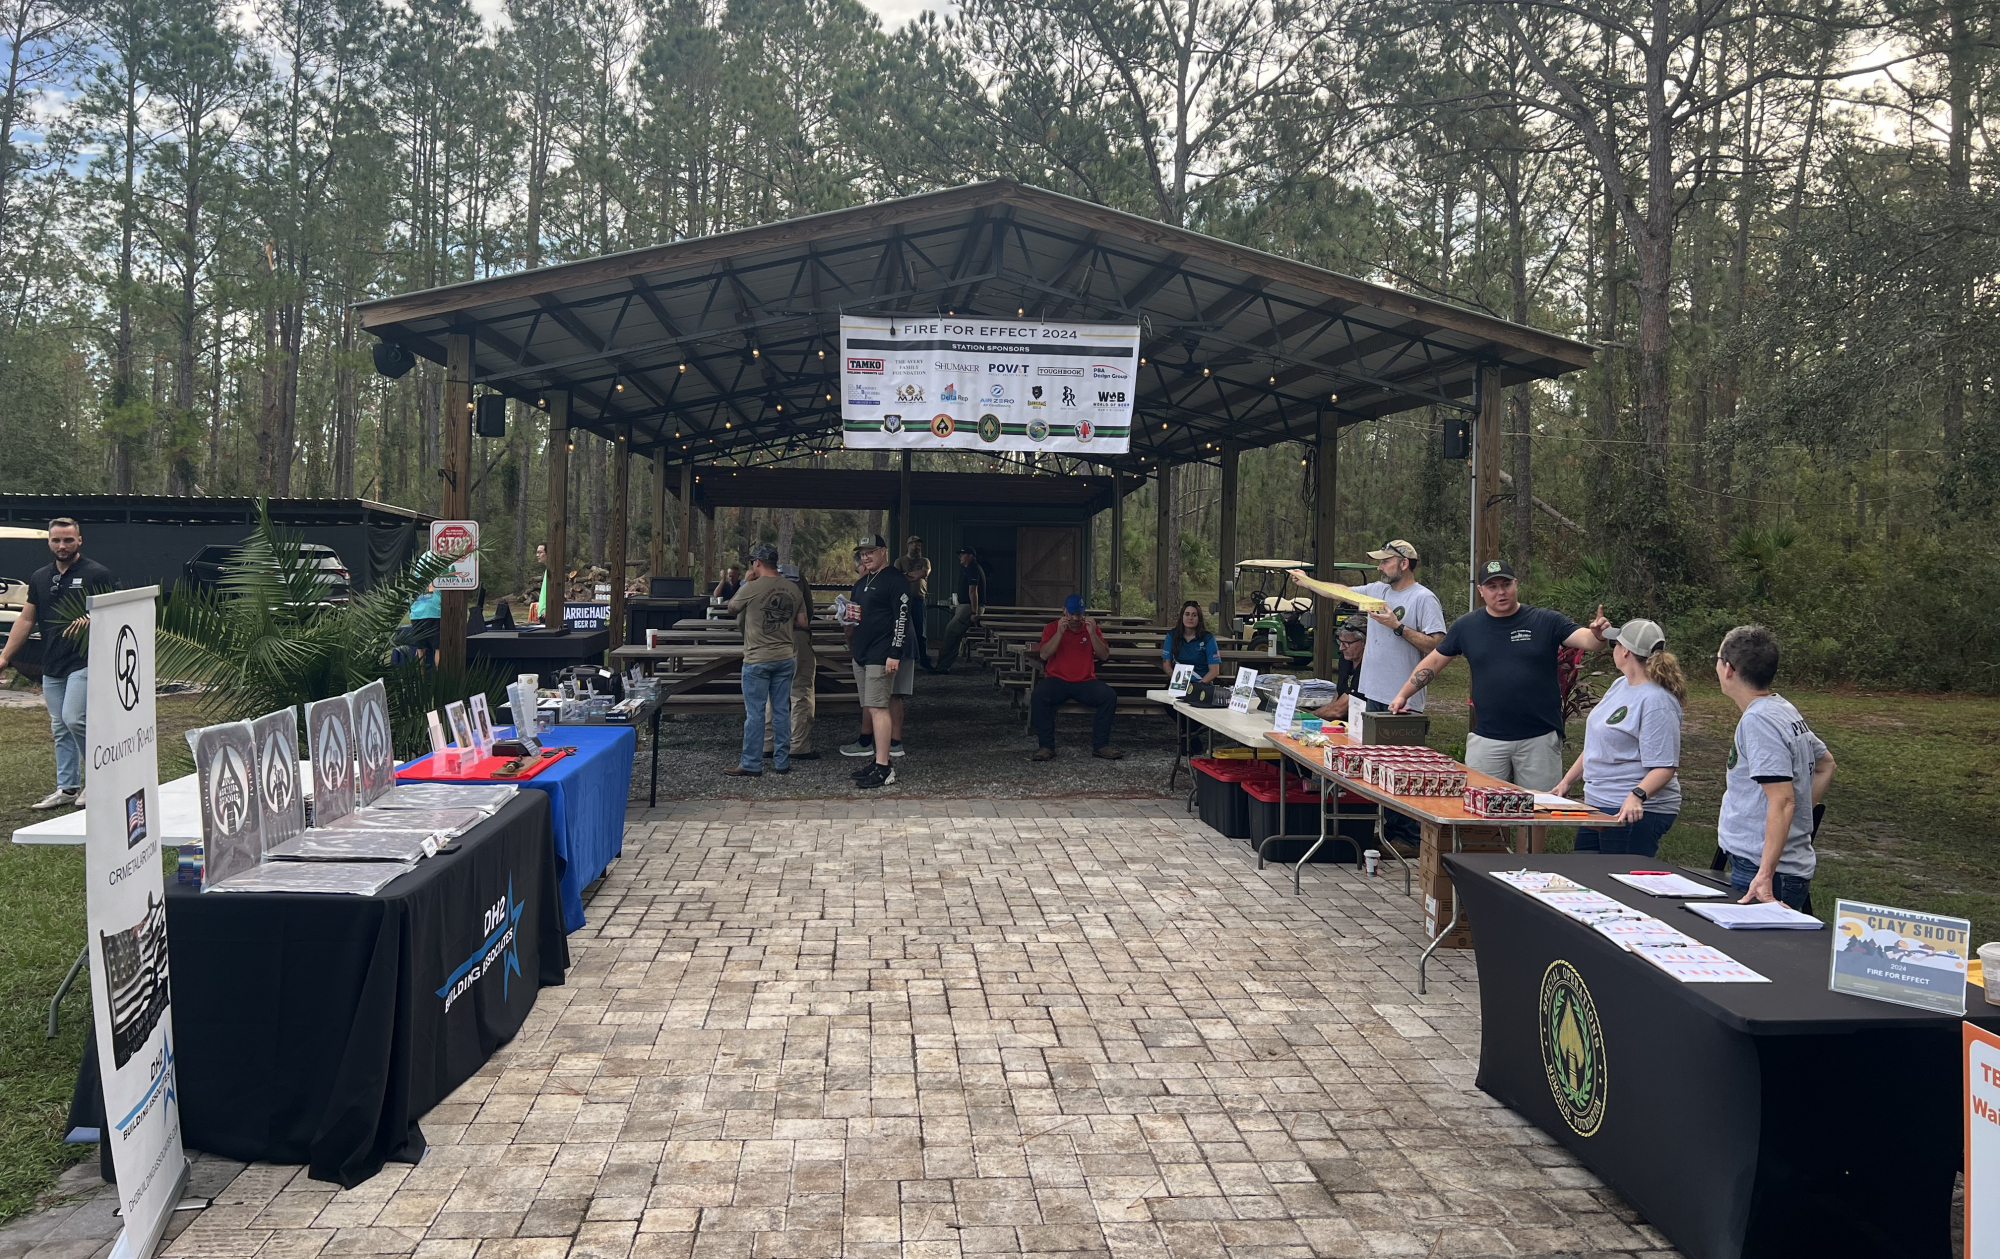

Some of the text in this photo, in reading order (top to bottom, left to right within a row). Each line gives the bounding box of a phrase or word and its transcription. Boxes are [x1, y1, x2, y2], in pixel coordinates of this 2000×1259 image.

[904, 325, 1077, 339] FIRE FOR EFFECT 2024
[952, 343, 984, 351] STATION
[850, 360, 881, 369] TAMKO
[935, 361, 980, 372] SHUMAKER
[1039, 368, 1082, 376] TOUGHBOOK
[438, 536, 471, 552] STOP
[563, 606, 611, 620] ARRIEHAUS
[574, 620, 588, 628] BEER
[896, 603, 908, 648] Columbia
[1391, 728, 1423, 737] WCRCA
[484, 895, 506, 938] DH2
[1866, 906, 1889, 915] SAVE
[1915, 914, 1940, 923] DATE
[1867, 916, 1967, 944] CLAY SHOOT
[444, 927, 513, 1014] BUILDING ASSOCIATES
[1890, 963, 1907, 971] 2024
[1866, 968, 1930, 985] FIRE FOR EFFECT
[1543, 966, 1600, 1049] SPECIAL OPERATIONS
[150, 1048, 163, 1083] DH2
[123, 1070, 171, 1141] BUILDING ASSOCIATES
[1548, 1064, 1602, 1131] MEMORIAL FOUNDATION
